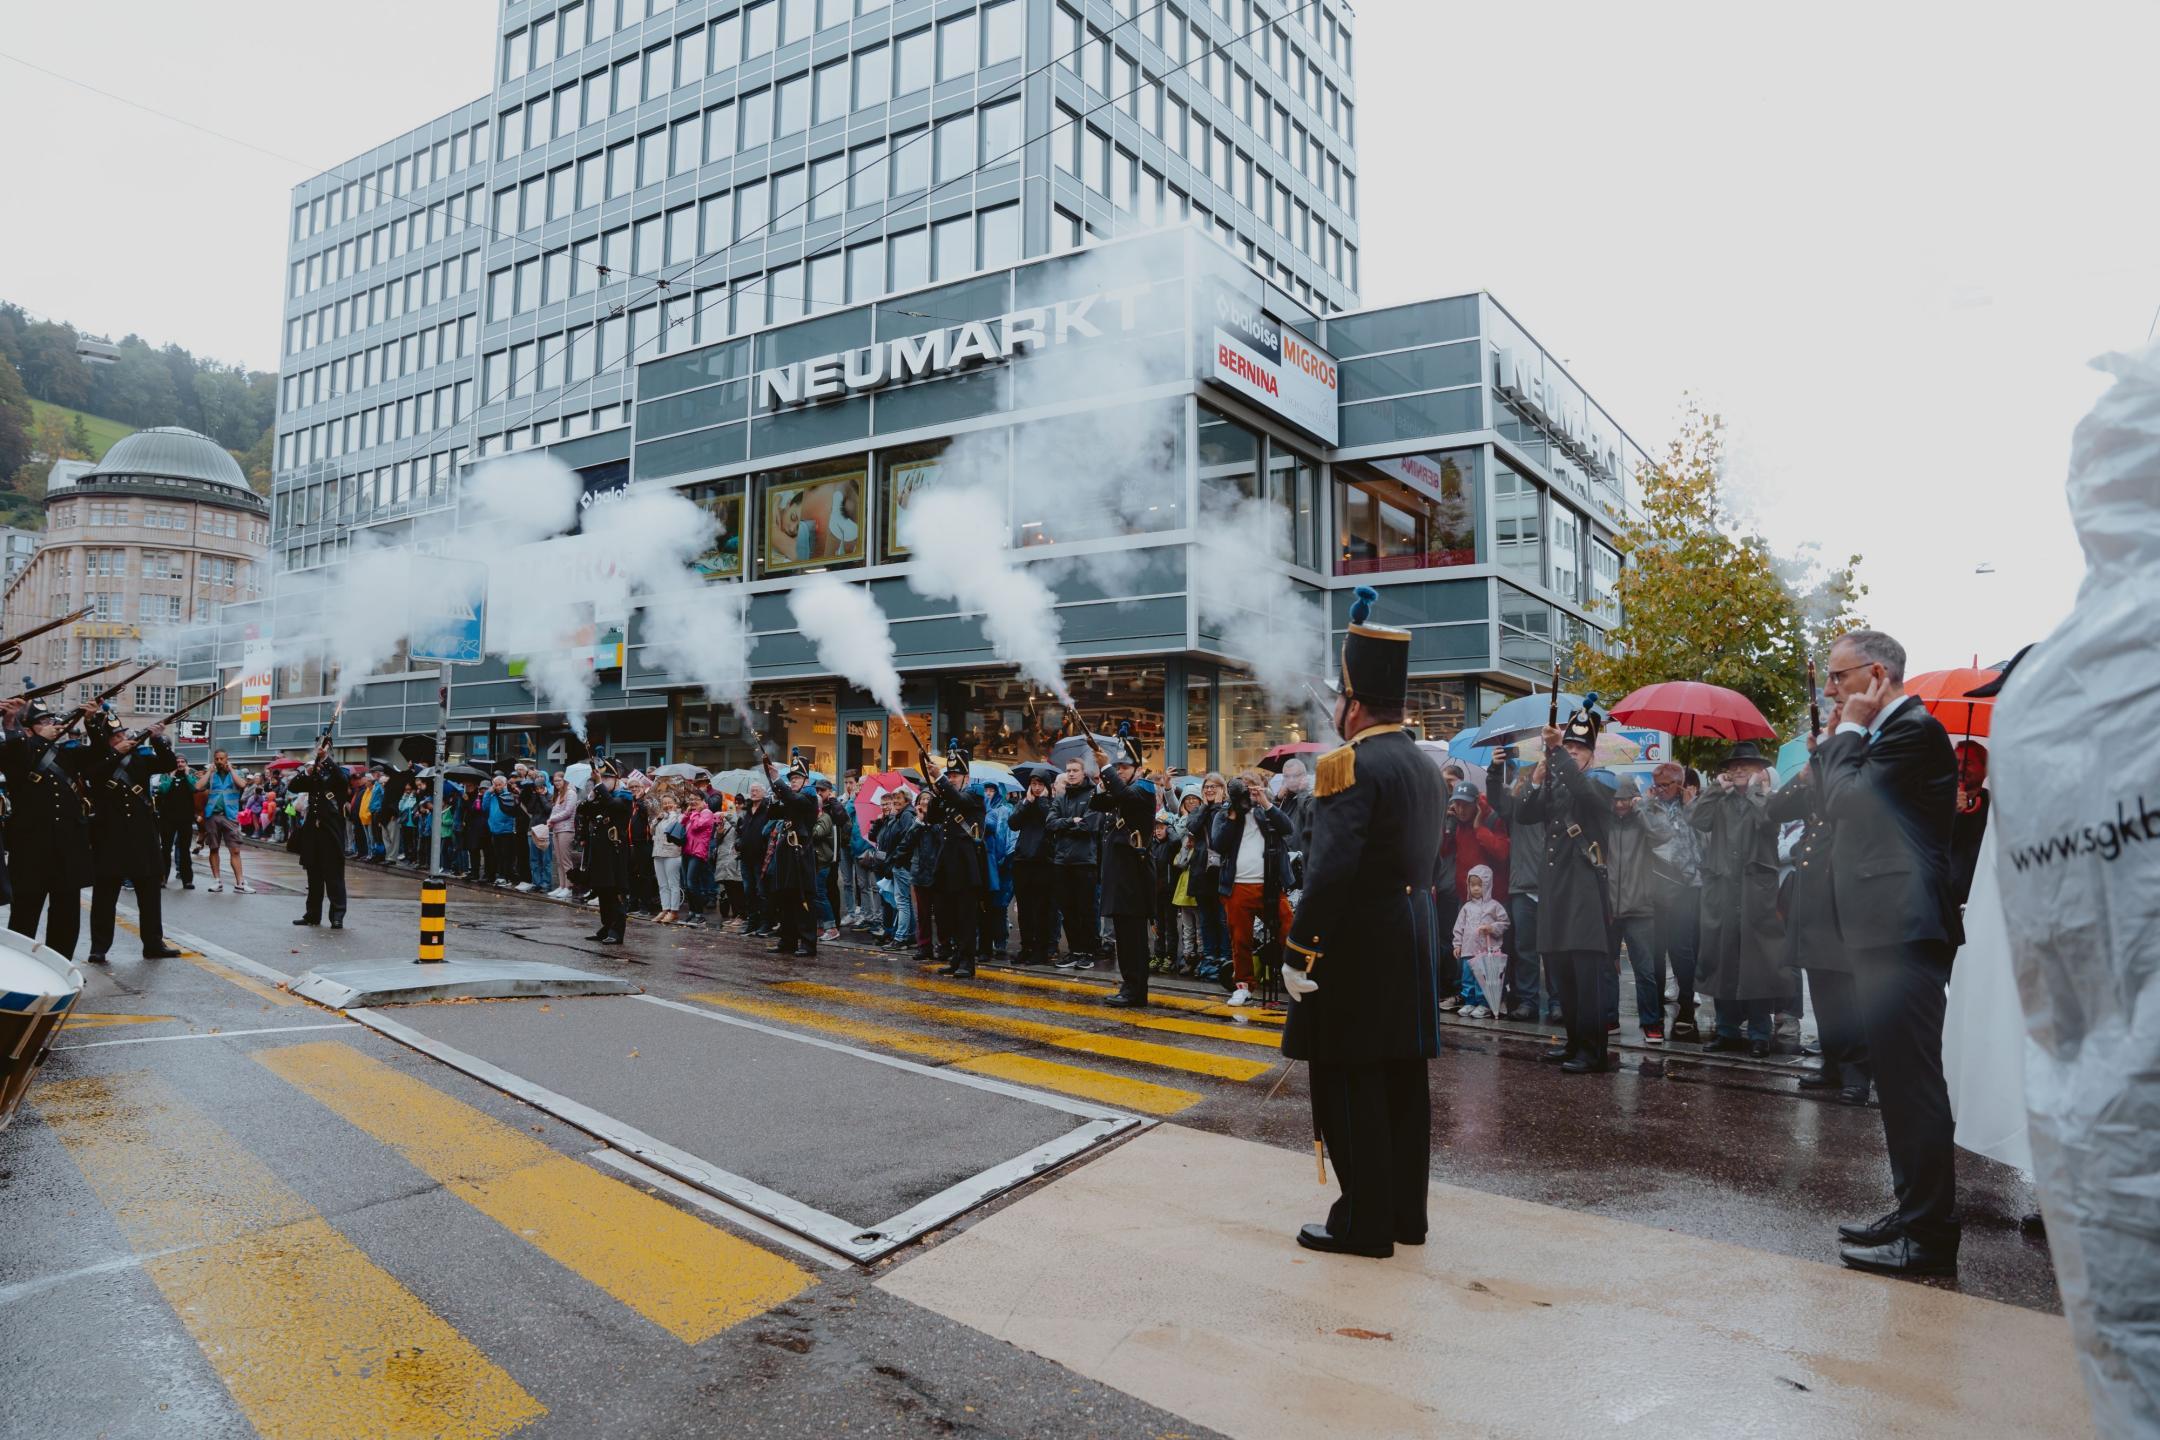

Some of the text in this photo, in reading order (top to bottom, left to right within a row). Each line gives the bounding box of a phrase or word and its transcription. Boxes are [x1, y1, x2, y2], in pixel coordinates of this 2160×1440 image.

[758, 282, 1152, 408] NEUMARKT
[1231, 301, 1279, 351] baloise
[1218, 343, 1279, 398] BERNINA
[1283, 335, 1337, 391] MIGROS
[547, 738, 568, 765] 4
[1651, 749, 1659, 758] 20
[2010, 795, 2160, 873] www.sgkb
